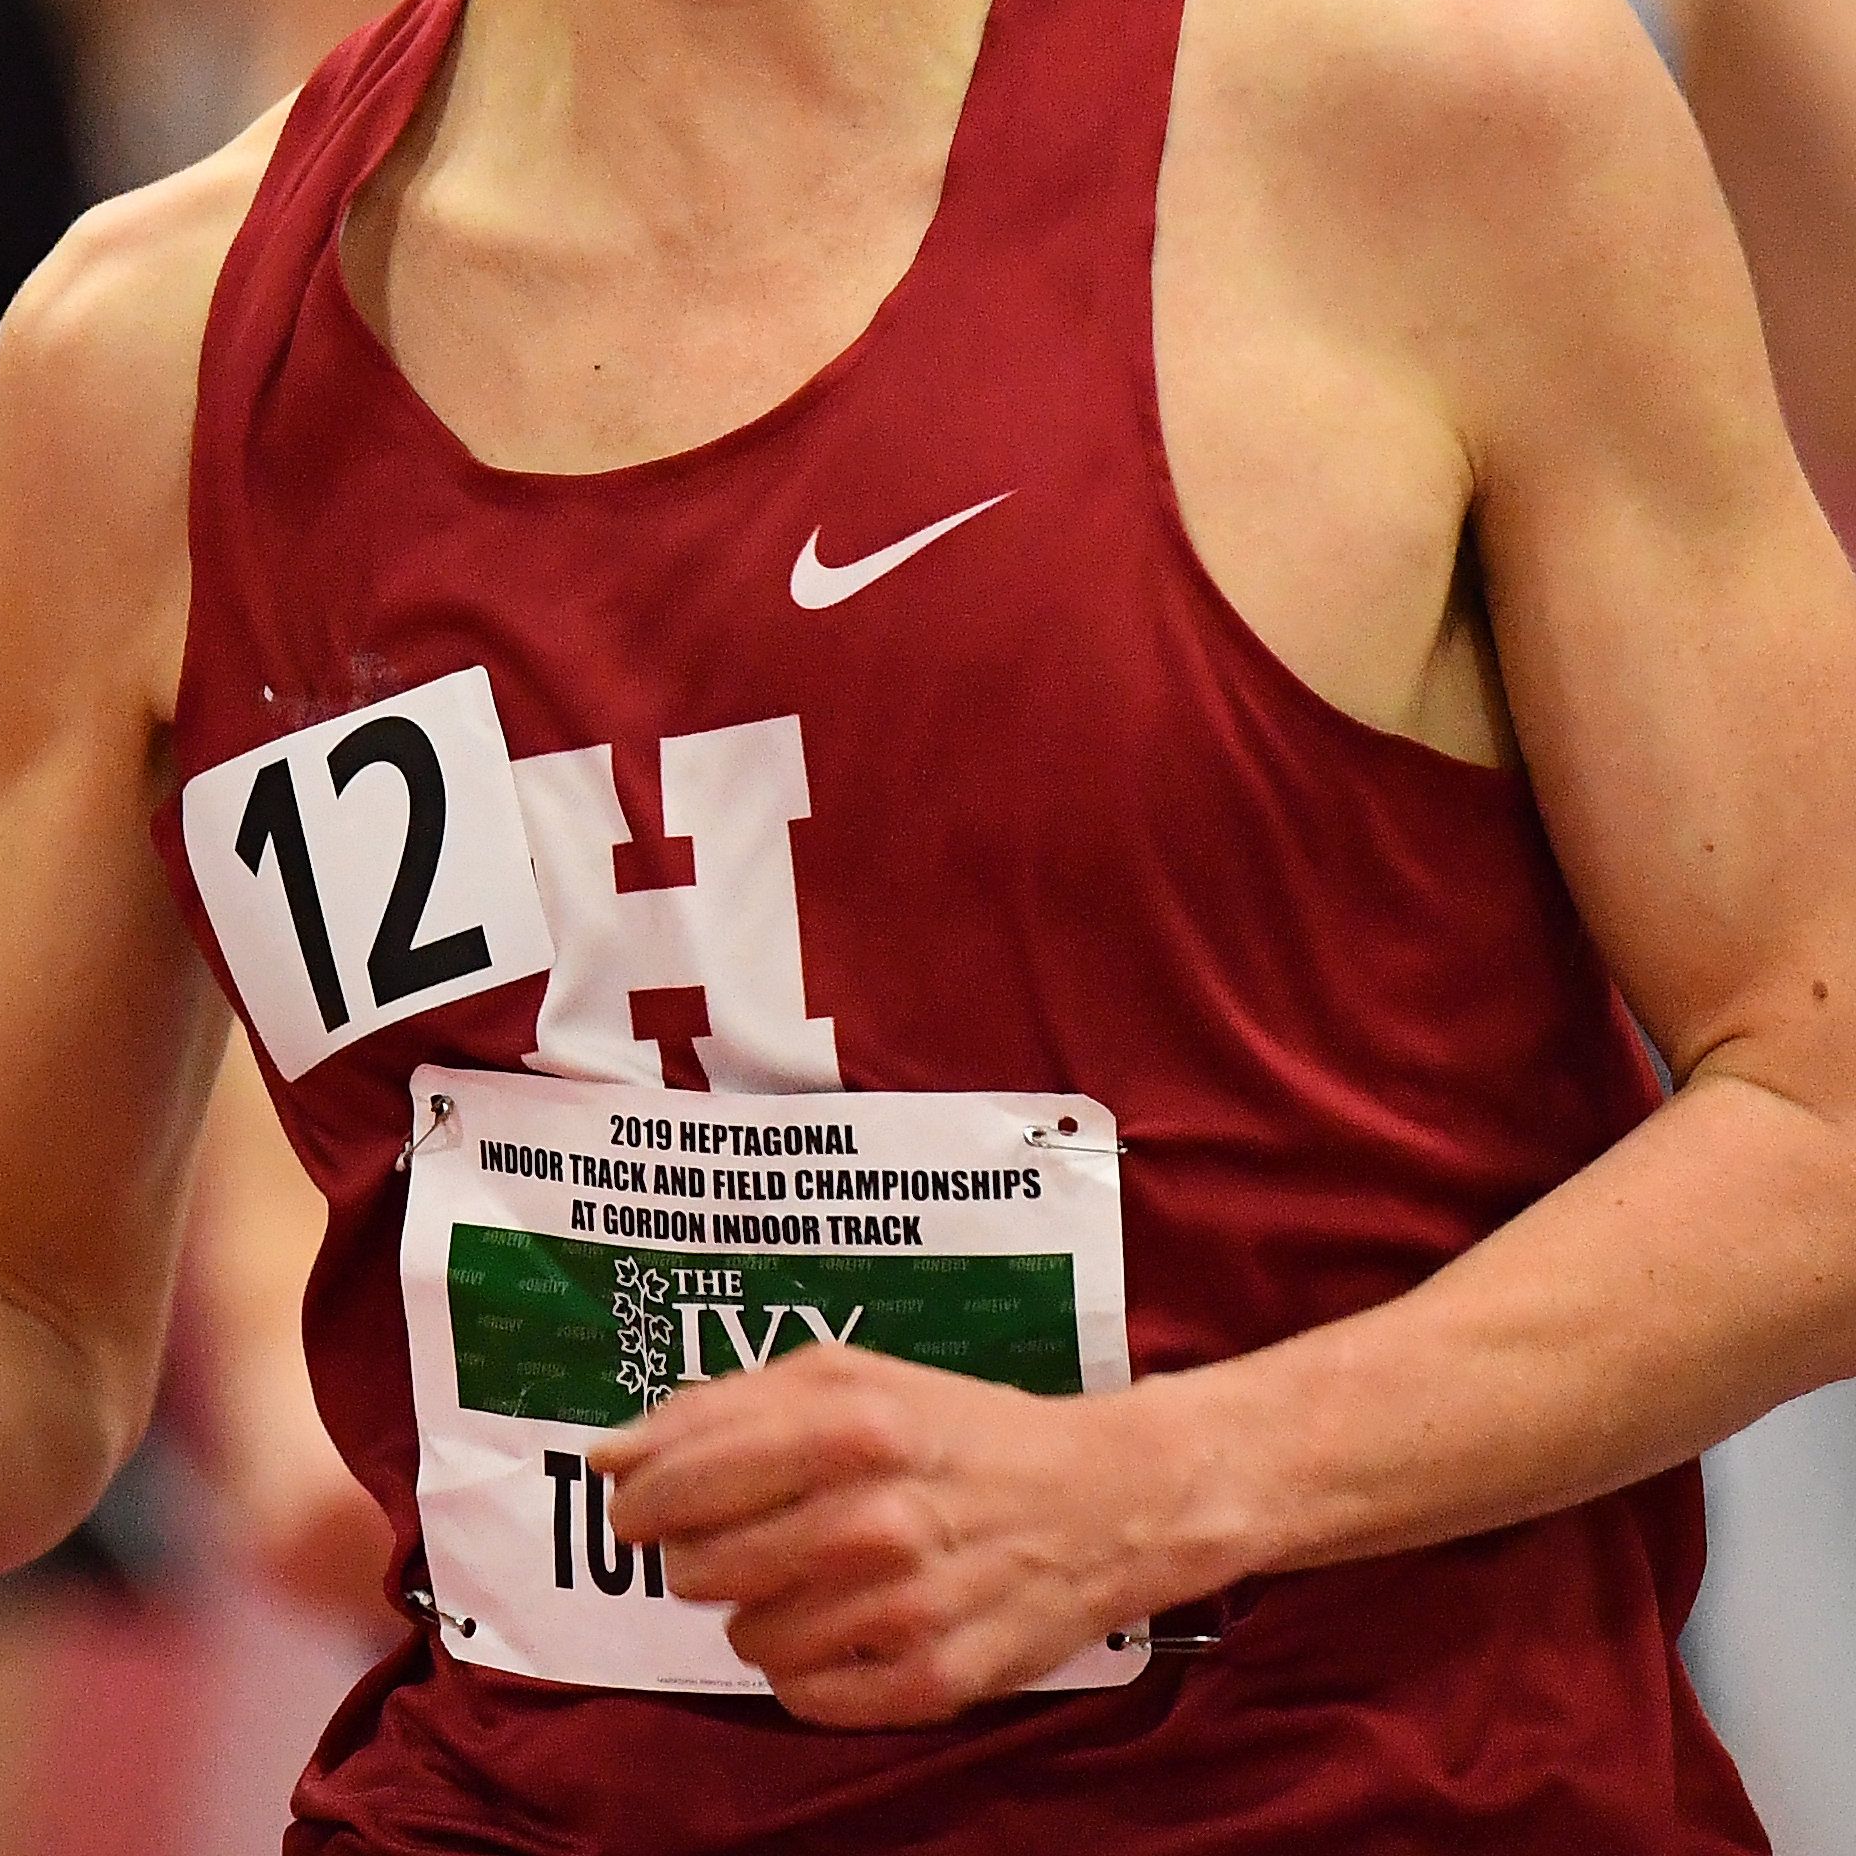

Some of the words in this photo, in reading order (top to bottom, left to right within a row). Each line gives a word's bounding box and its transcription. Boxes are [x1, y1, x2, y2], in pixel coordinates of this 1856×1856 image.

[235, 715, 492, 1034] 12
[510, 715, 843, 1094] H
[611, 1115, 671, 1150] 2019
[680, 1122, 859, 1156] HEPTAGONAL
[480, 1140, 564, 1183] INDOOR
[569, 1154, 648, 1194] TRACK
[654, 1165, 705, 1197] AND
[713, 1170, 787, 1201] FIELD
[795, 1169, 1042, 1201] CHAMPIONSHIPS
[571, 1199, 597, 1231] AT
[604, 1204, 706, 1243] GORDON
[713, 1215, 820, 1245] INDOOR
[826, 1216, 923, 1245] TRACK
[671, 1268, 743, 1296] THE
